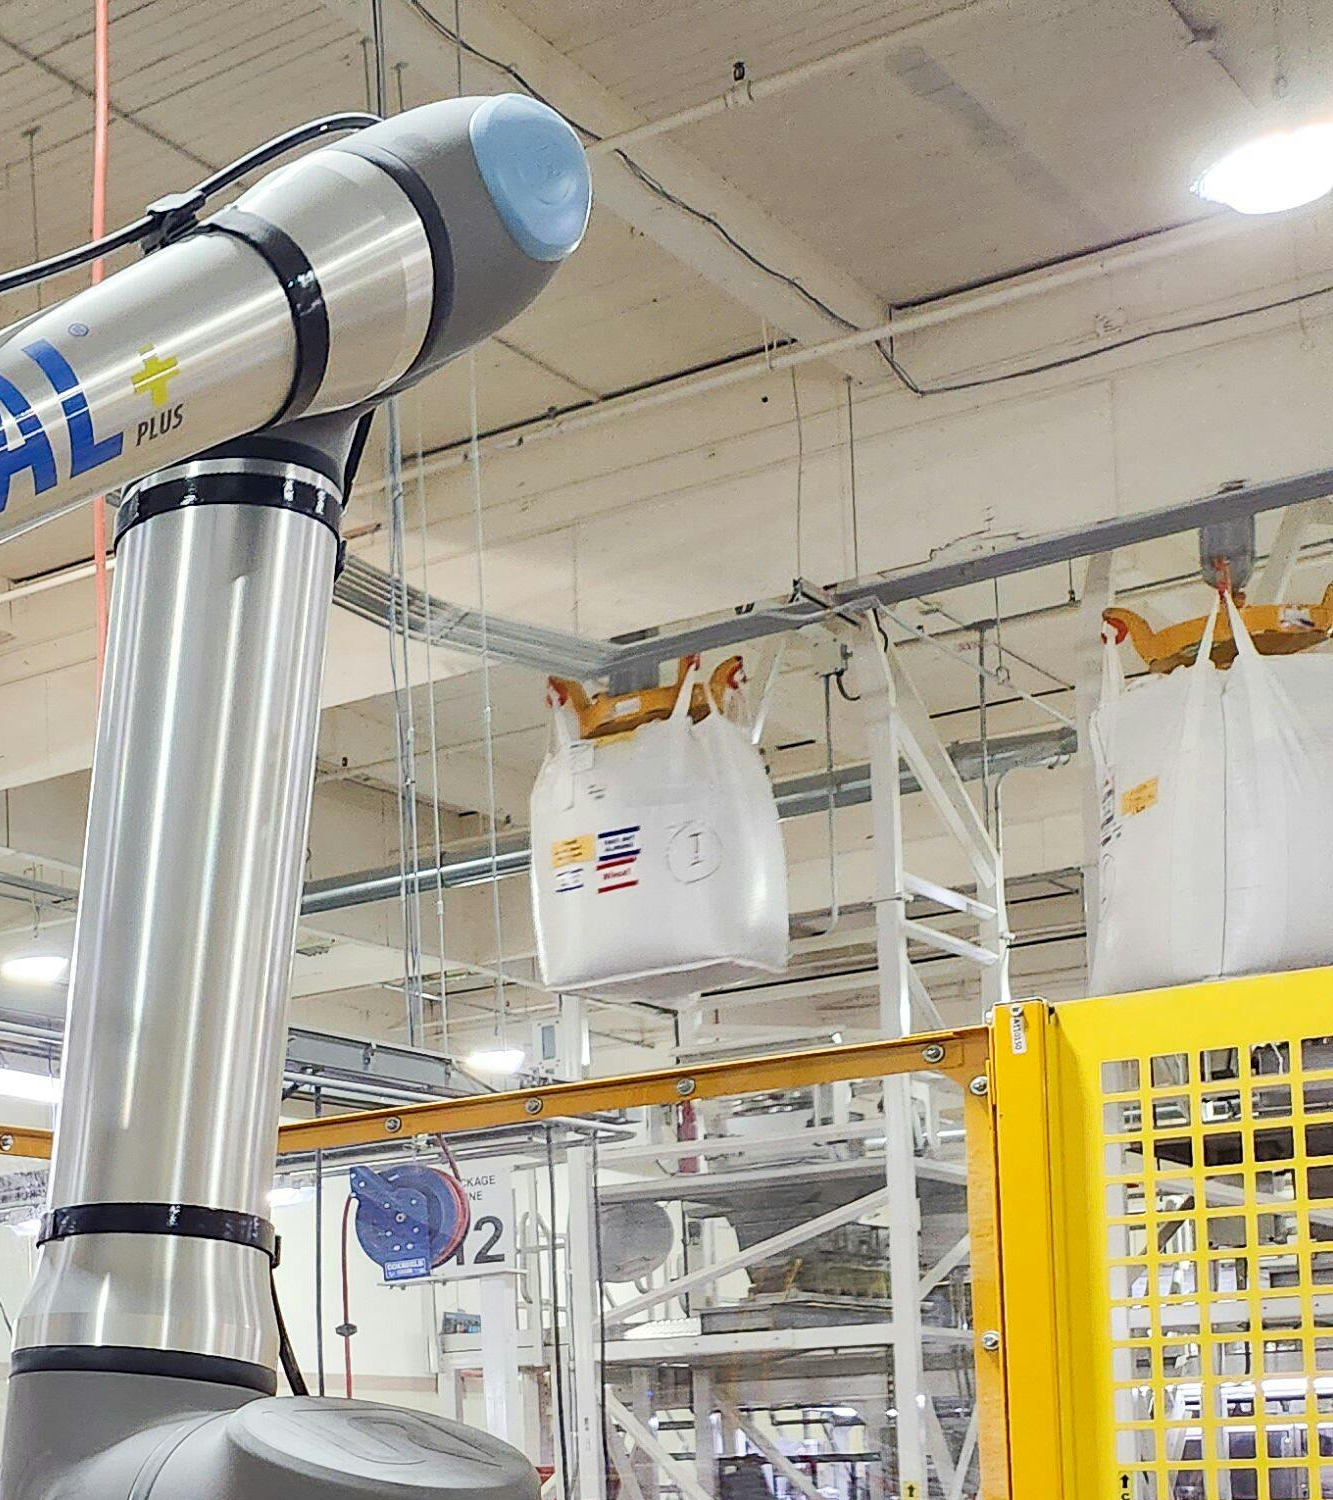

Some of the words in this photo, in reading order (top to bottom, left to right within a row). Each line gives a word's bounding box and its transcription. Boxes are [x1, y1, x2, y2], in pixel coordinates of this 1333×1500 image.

[135, 404, 184, 446] PLUS
[461, 1175, 495, 1187] CKAGE
[469, 1192, 482, 1200] NE
